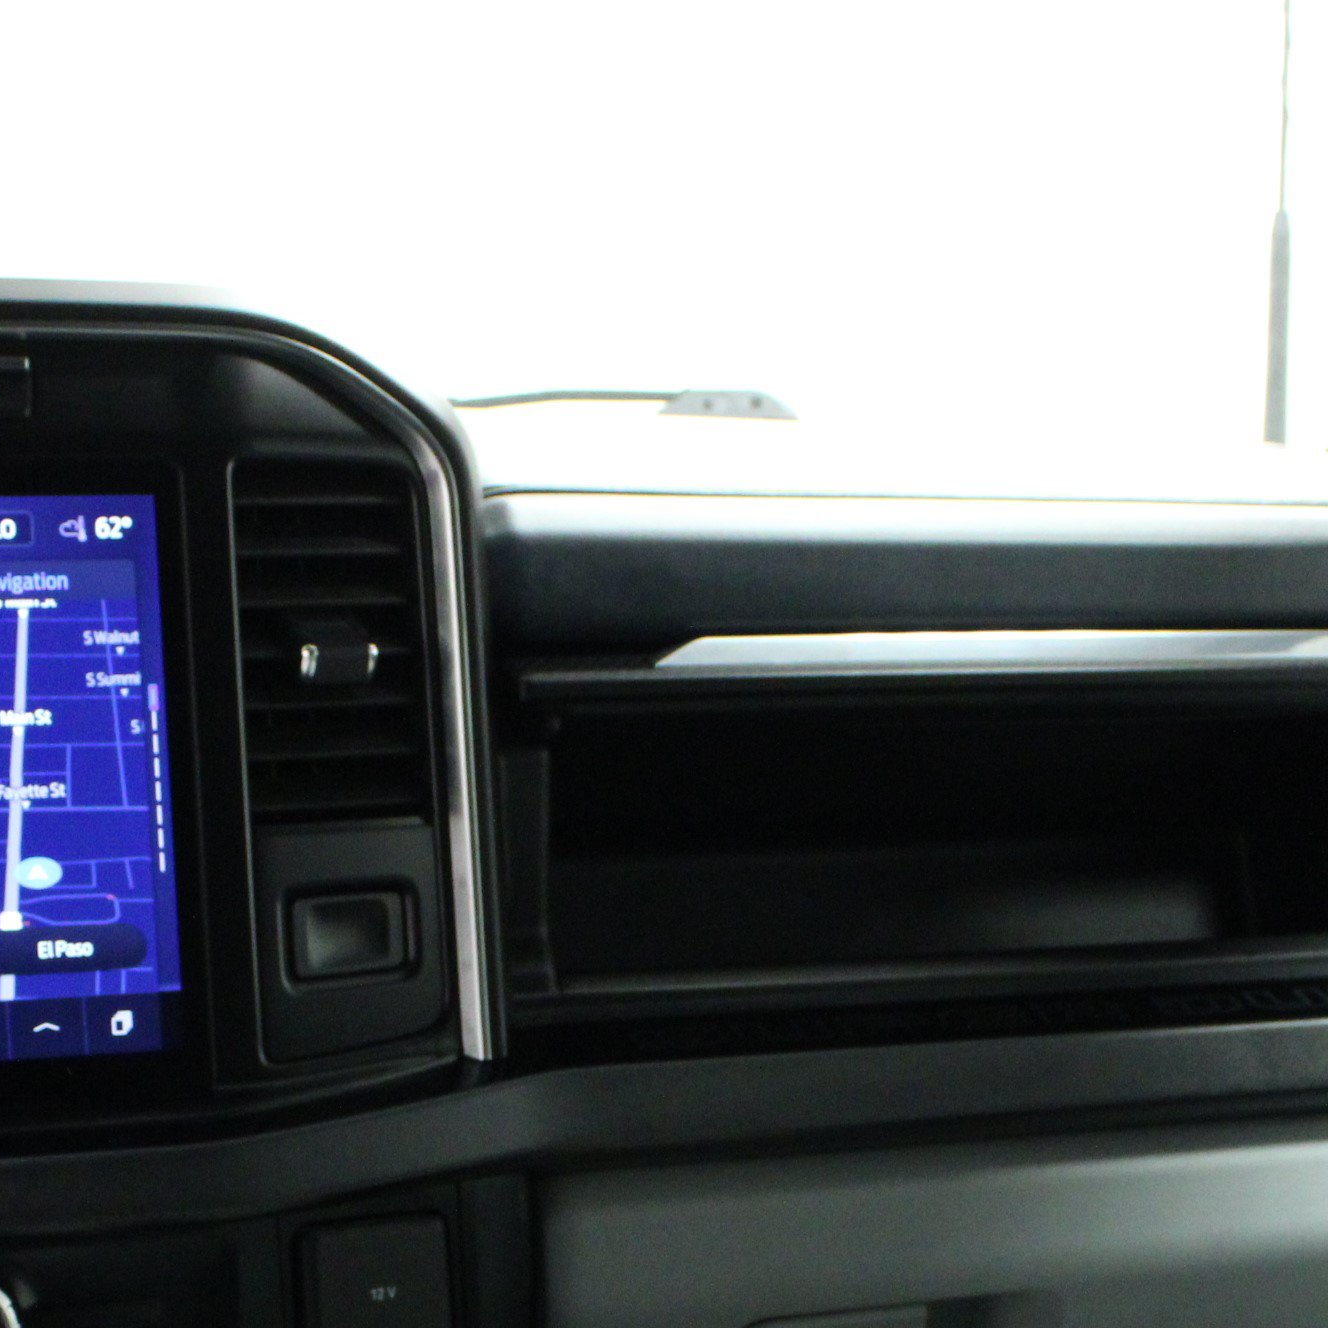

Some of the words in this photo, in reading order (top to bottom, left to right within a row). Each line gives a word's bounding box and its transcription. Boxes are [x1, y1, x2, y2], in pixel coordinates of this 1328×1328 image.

[94, 515, 133, 540] 62°
[83, 630, 94, 646] S
[94, 630, 140, 645] Walnut
[85, 671, 96, 688] S
[34, 708, 53, 726] St
[49, 782, 67, 799] St
[37, 941, 54, 960] El
[54, 939, 95, 959] Paso
